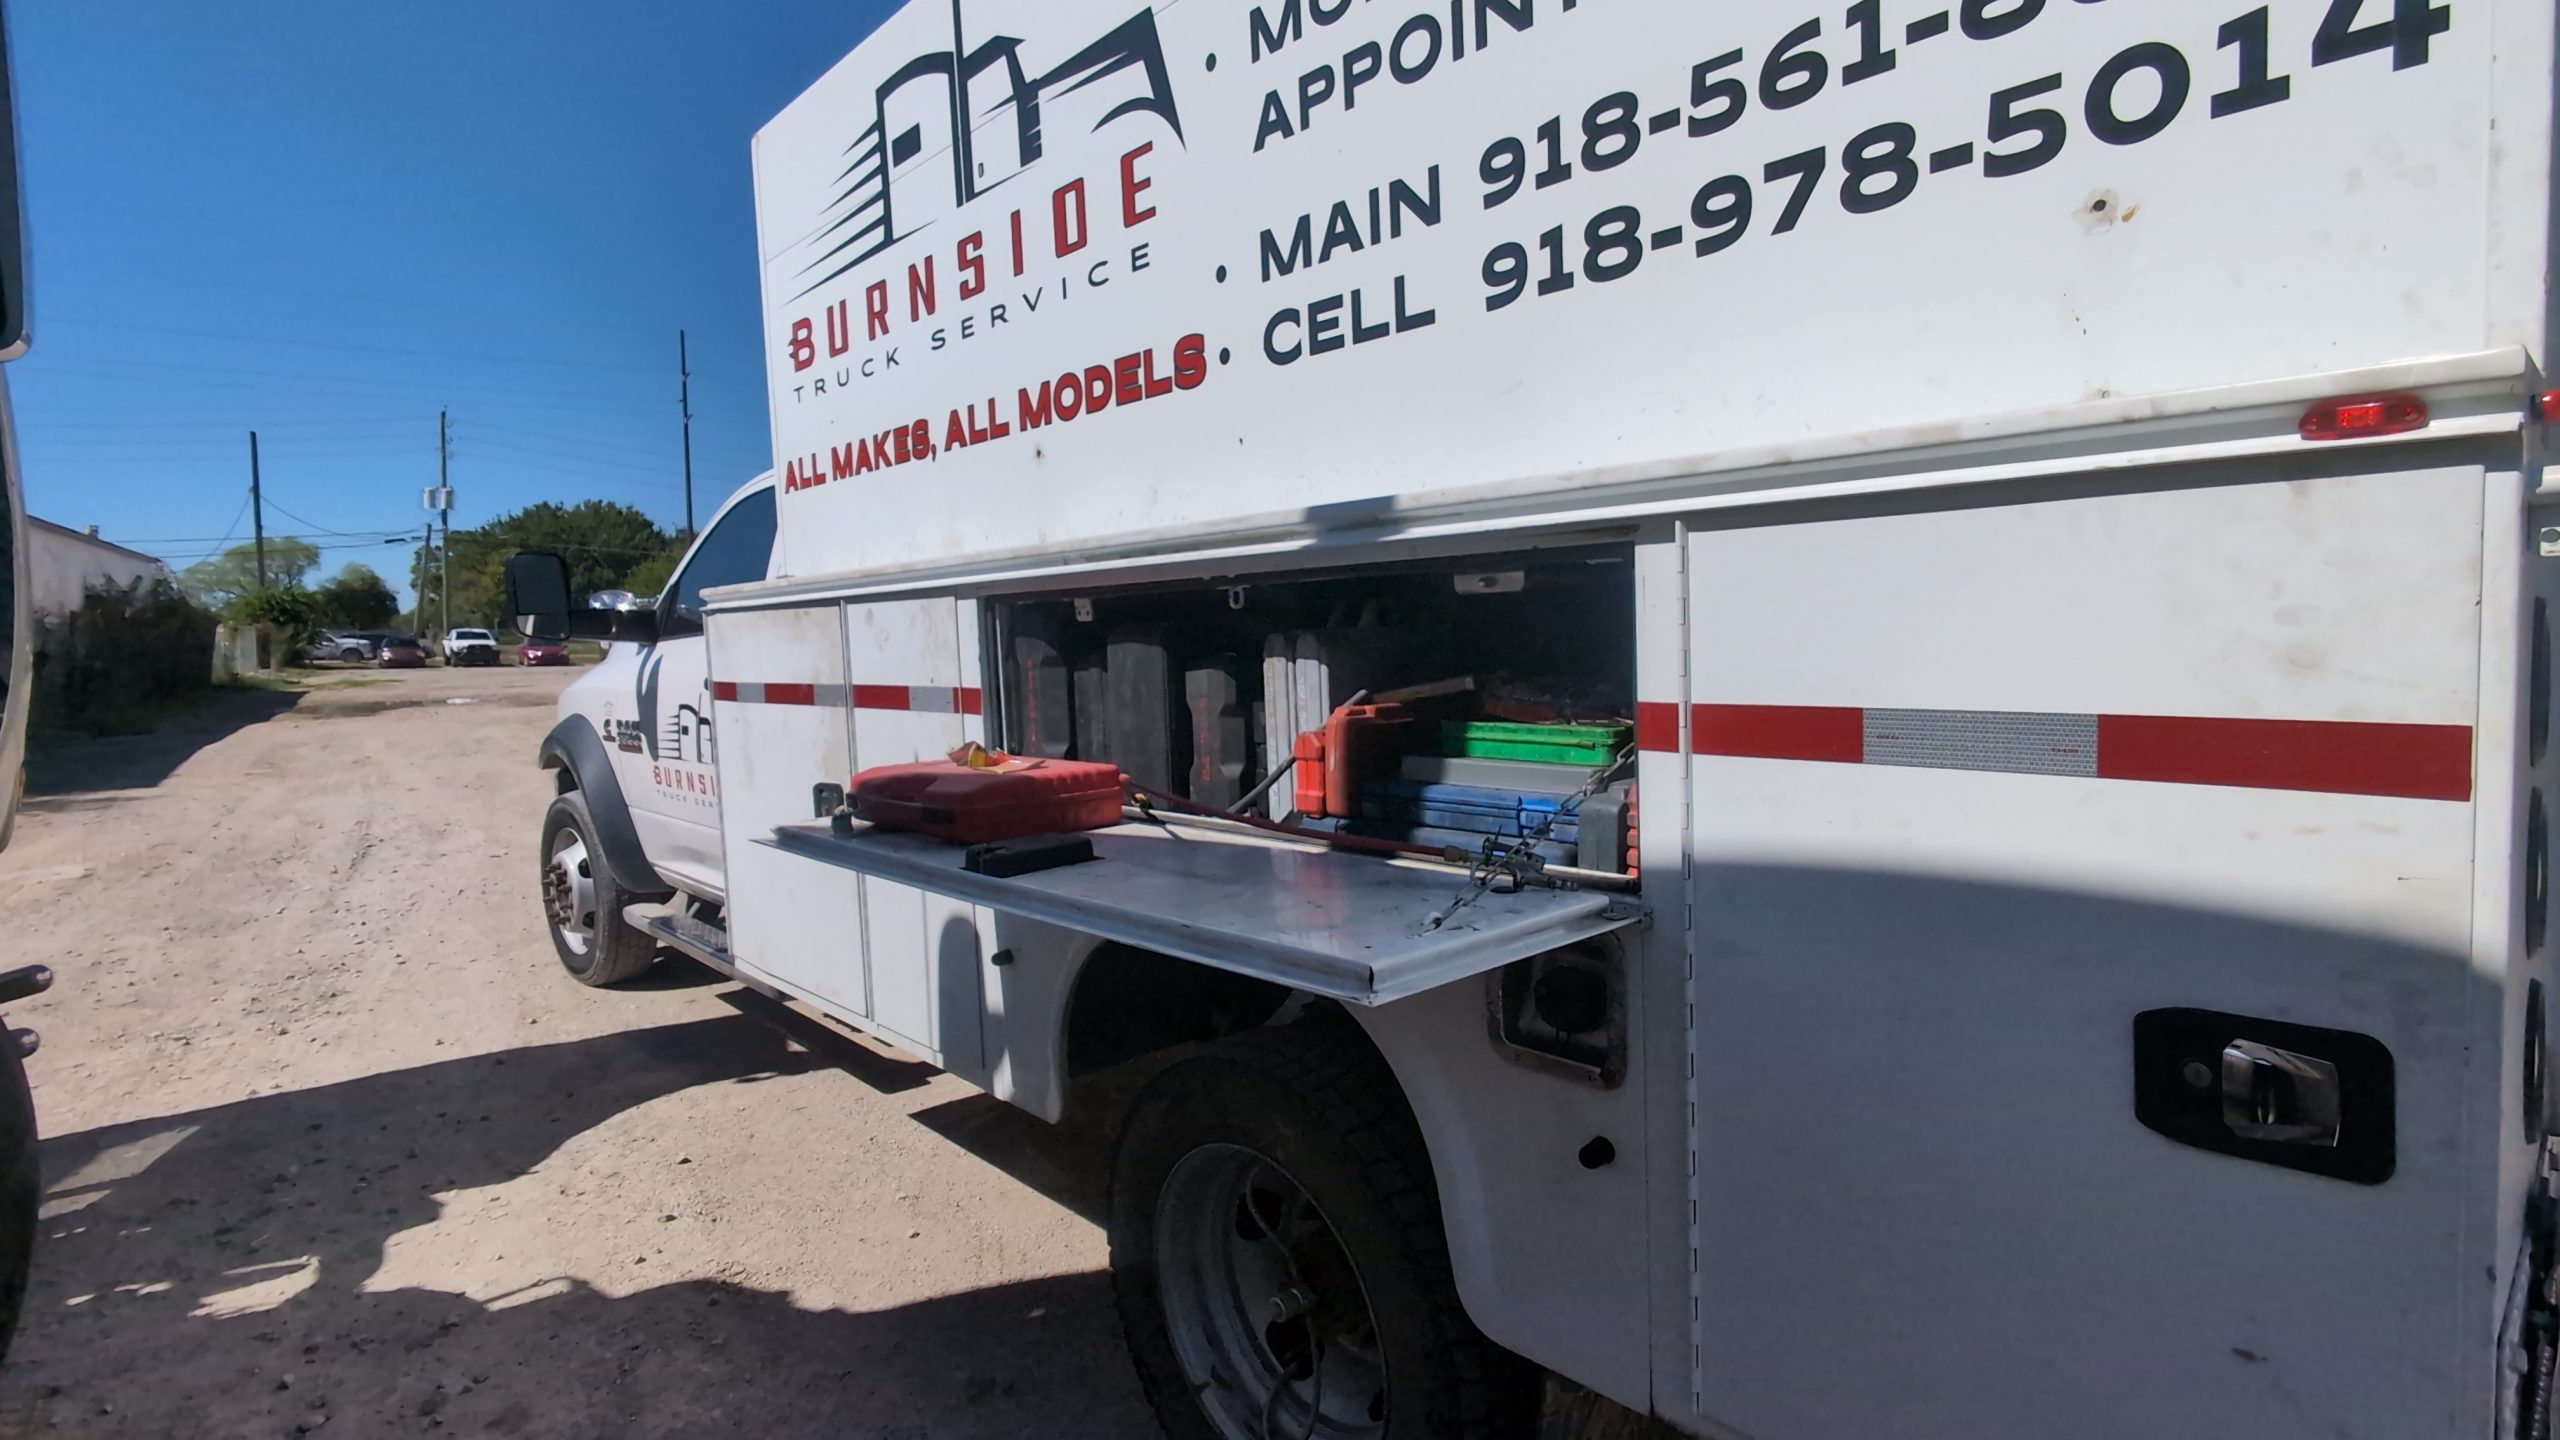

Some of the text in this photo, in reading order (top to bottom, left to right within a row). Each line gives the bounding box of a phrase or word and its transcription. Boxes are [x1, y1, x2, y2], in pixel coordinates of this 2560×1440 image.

[1254, 0, 1577, 153] APPOIN
[1259, 0, 2105, 282] MAIN 918-561-
[788, 141, 1157, 373] BURNSIDE
[1263, 0, 2451, 366] CELL 918-978-5014
[785, 333, 1208, 495] ALL MAKES, ALL MODELS
[793, 242, 1151, 404] TRUCK SERVICE
